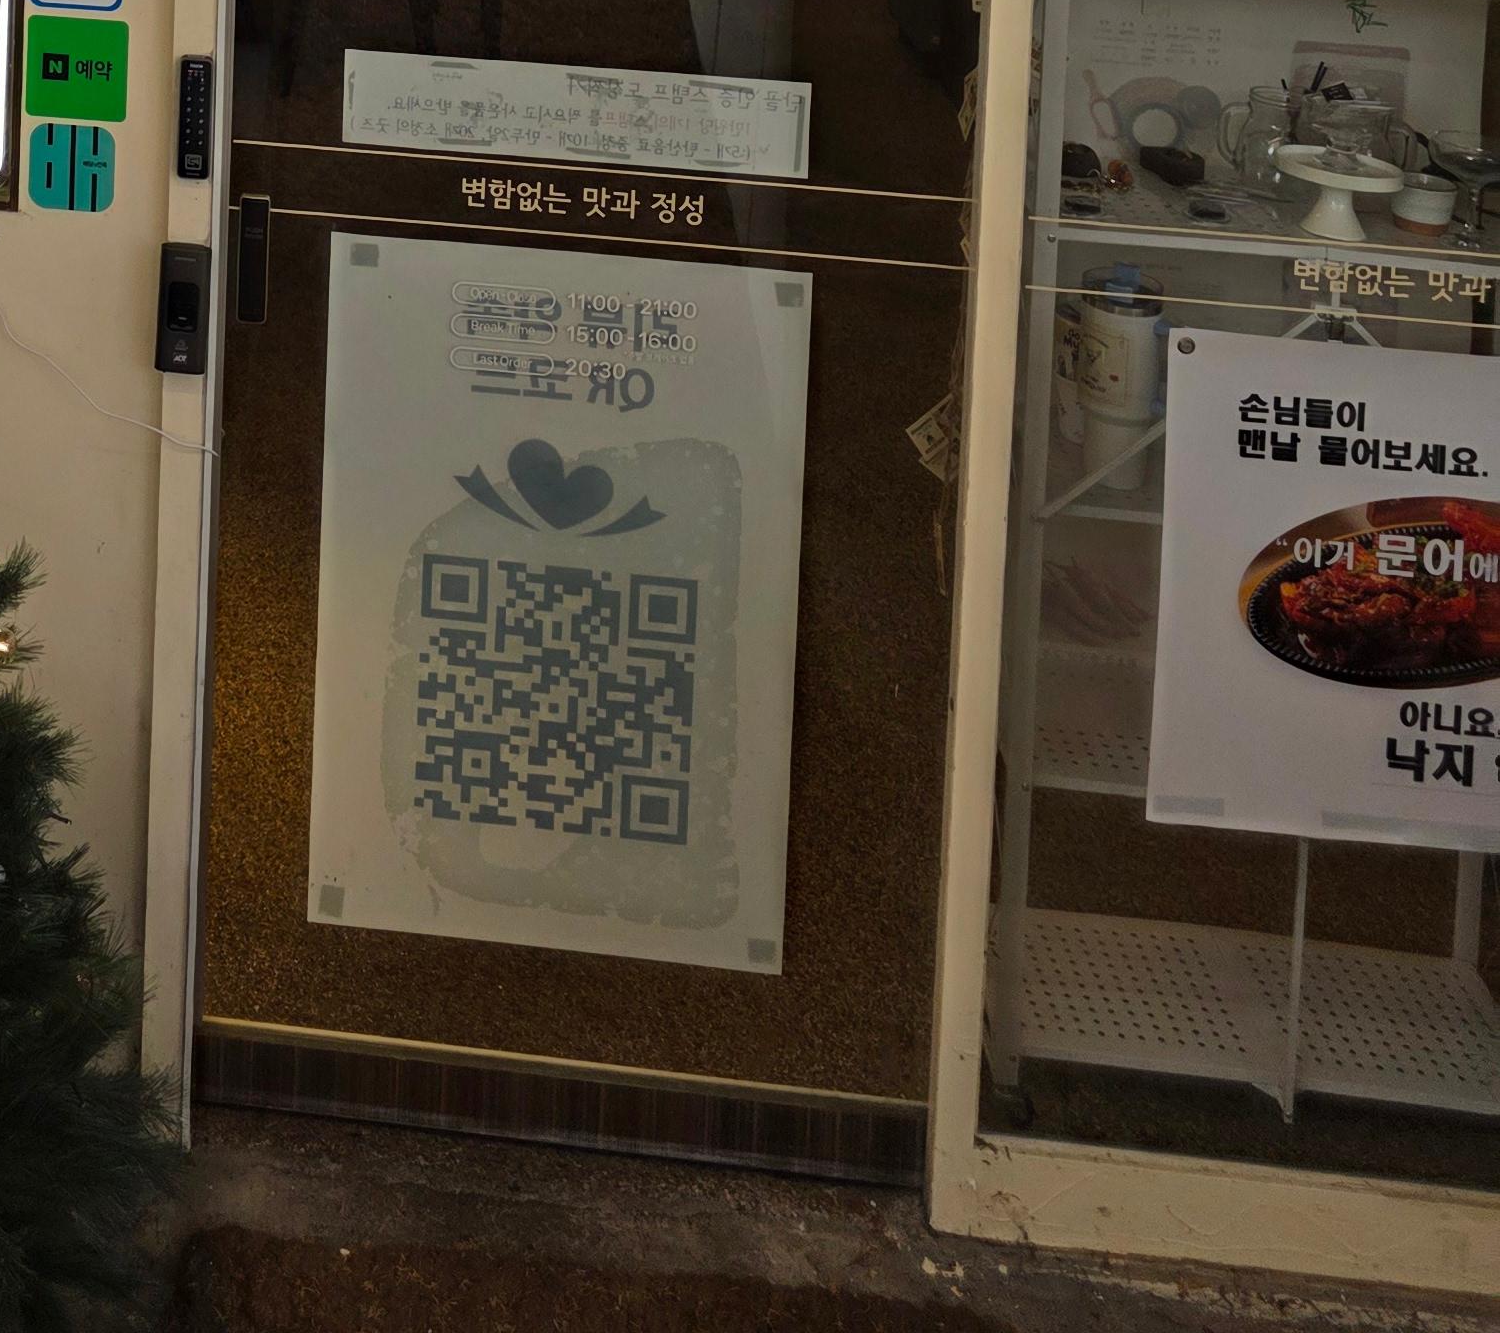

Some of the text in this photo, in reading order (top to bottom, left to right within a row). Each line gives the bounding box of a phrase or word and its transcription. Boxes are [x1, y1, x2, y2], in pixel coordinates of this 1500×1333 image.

[75, 59, 113, 82] 예약
[462, 177, 705, 226] 변함없는 맛과 정성
[1293, 259, 1491, 304] 변함없는 맛과
[567, 293, 621, 313] 11:00
[640, 299, 697, 319] 21:00
[470, 319, 505, 334] Break
[566, 325, 623, 346] 15:00
[638, 333, 697, 352] 16:00
[472, 353, 499, 367] Last
[564, 358, 627, 380] 20:30
[1238, 393, 1366, 432] 손님들이
[1238, 429, 1488, 477] 맨날 물어보세요.
[1386, 737, 1474, 787] 낙지
